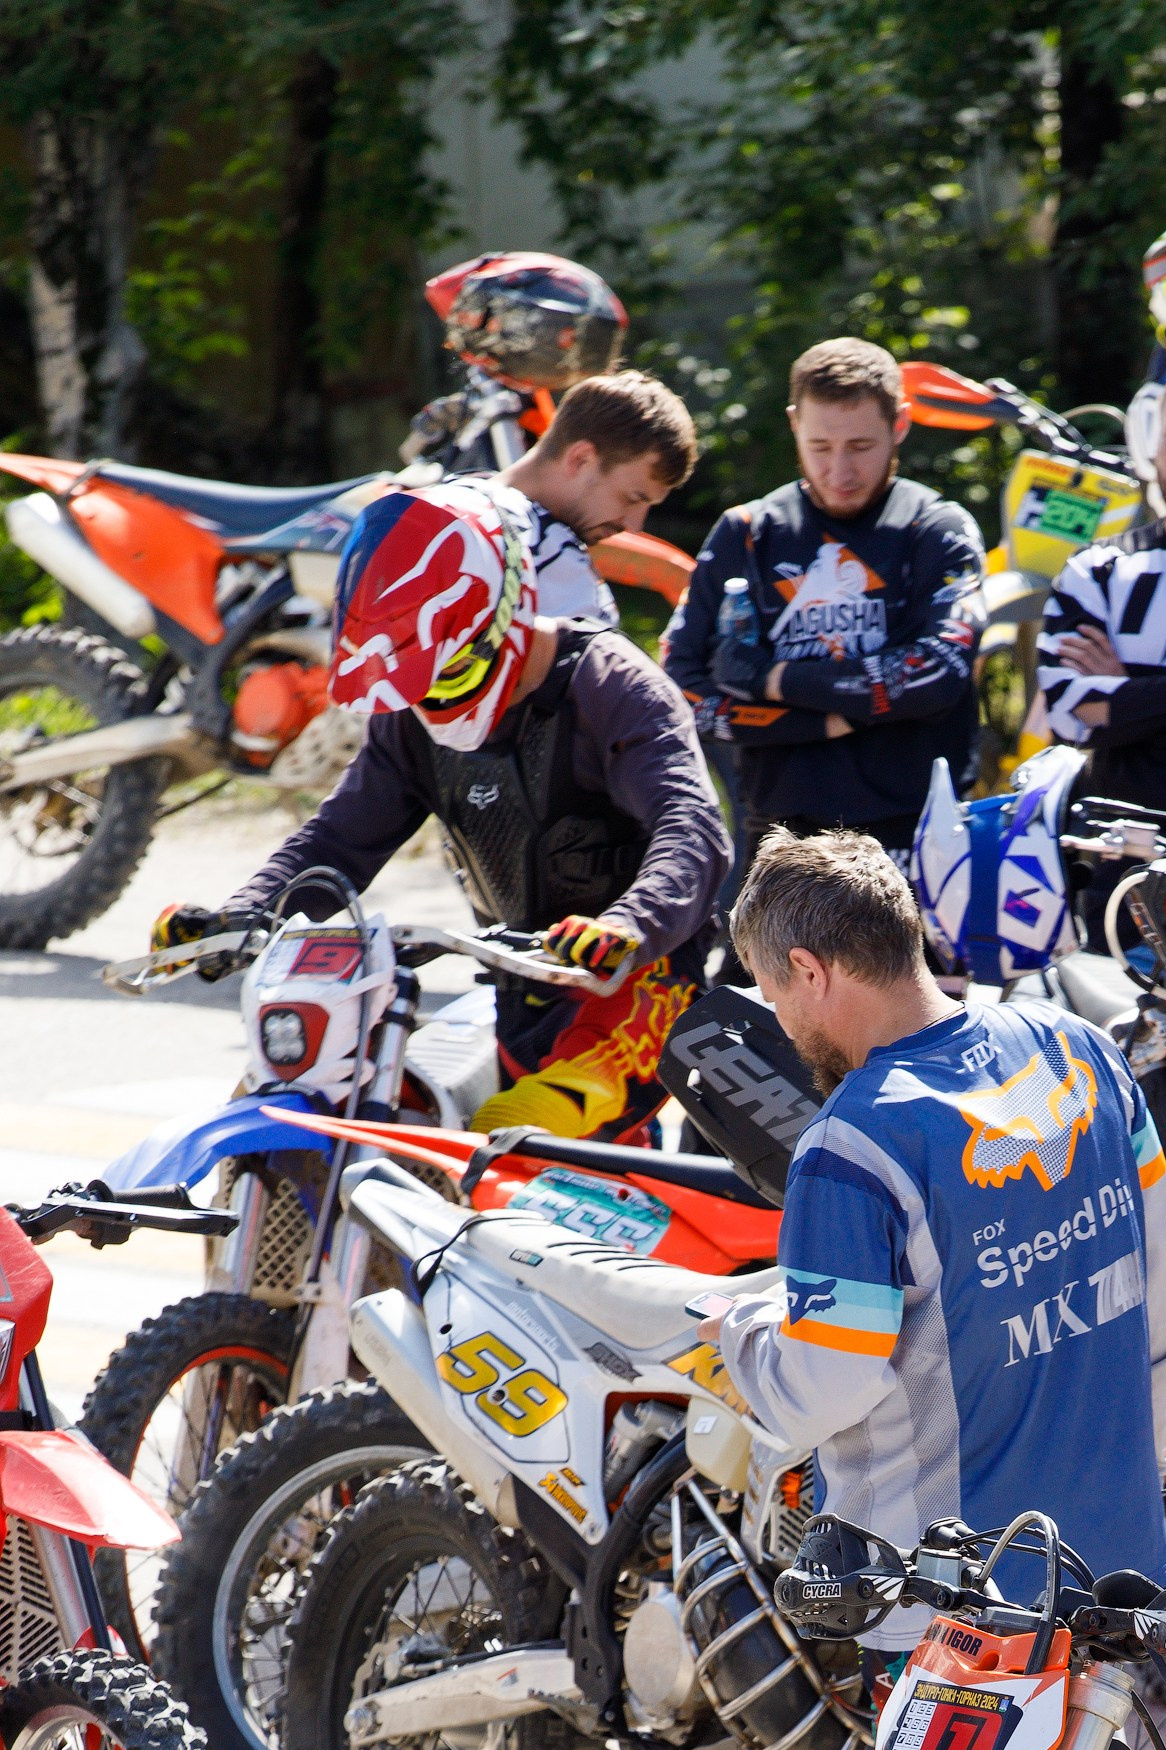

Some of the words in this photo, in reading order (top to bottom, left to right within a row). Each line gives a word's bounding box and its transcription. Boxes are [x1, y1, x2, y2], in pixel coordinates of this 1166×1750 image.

[962, 1036, 1002, 1073] FOX
[670, 1020, 822, 1153] LEAT
[972, 1218, 1007, 1247] FOX
[977, 1196, 1097, 1290] Speed
[1000, 1281, 1092, 1368] MX
[436, 1331, 569, 1438] 59
[803, 1583, 841, 1600] CYCRA
[950, 1628, 983, 1657] IGOR
[979, 1695, 1000, 1711] 2024
